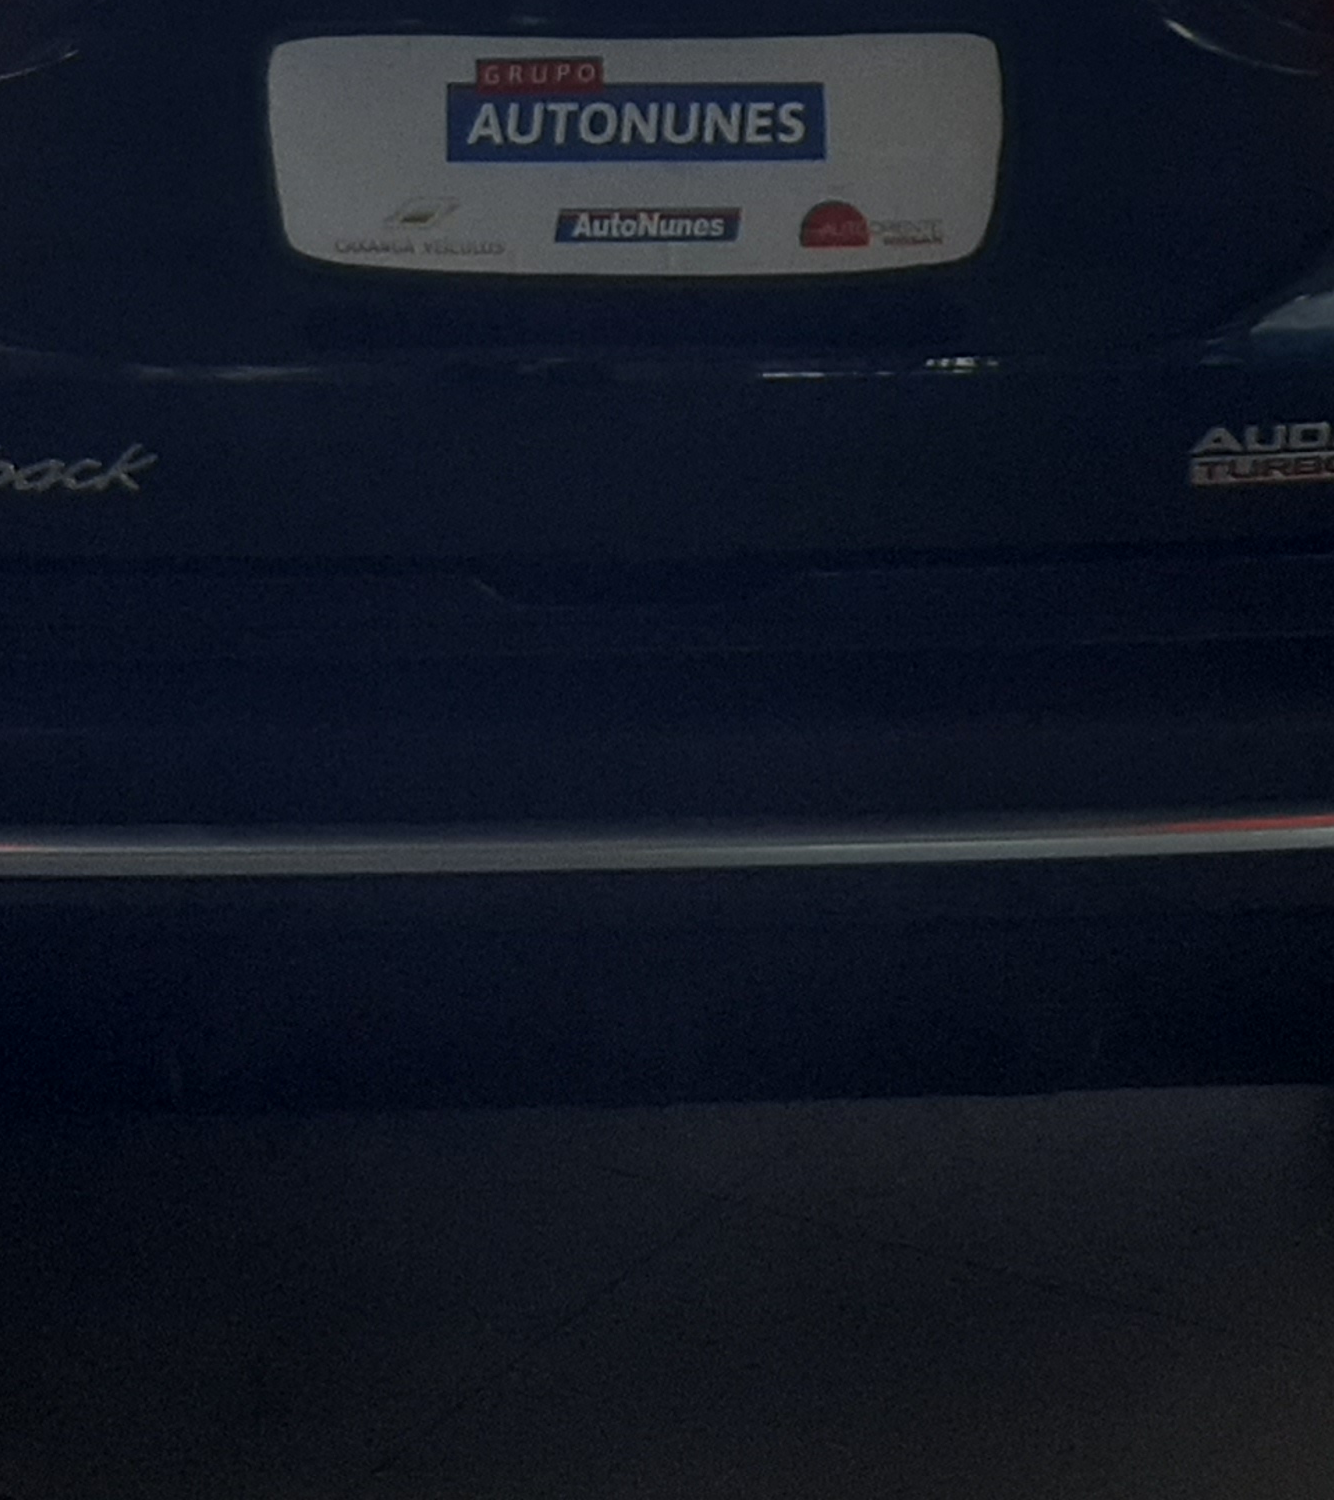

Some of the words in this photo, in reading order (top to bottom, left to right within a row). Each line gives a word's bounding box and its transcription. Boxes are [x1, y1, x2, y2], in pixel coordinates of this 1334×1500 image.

[483, 61, 598, 87] GRUPO
[466, 101, 806, 145] AUTONUNES
[571, 211, 726, 240] AutoNunes
